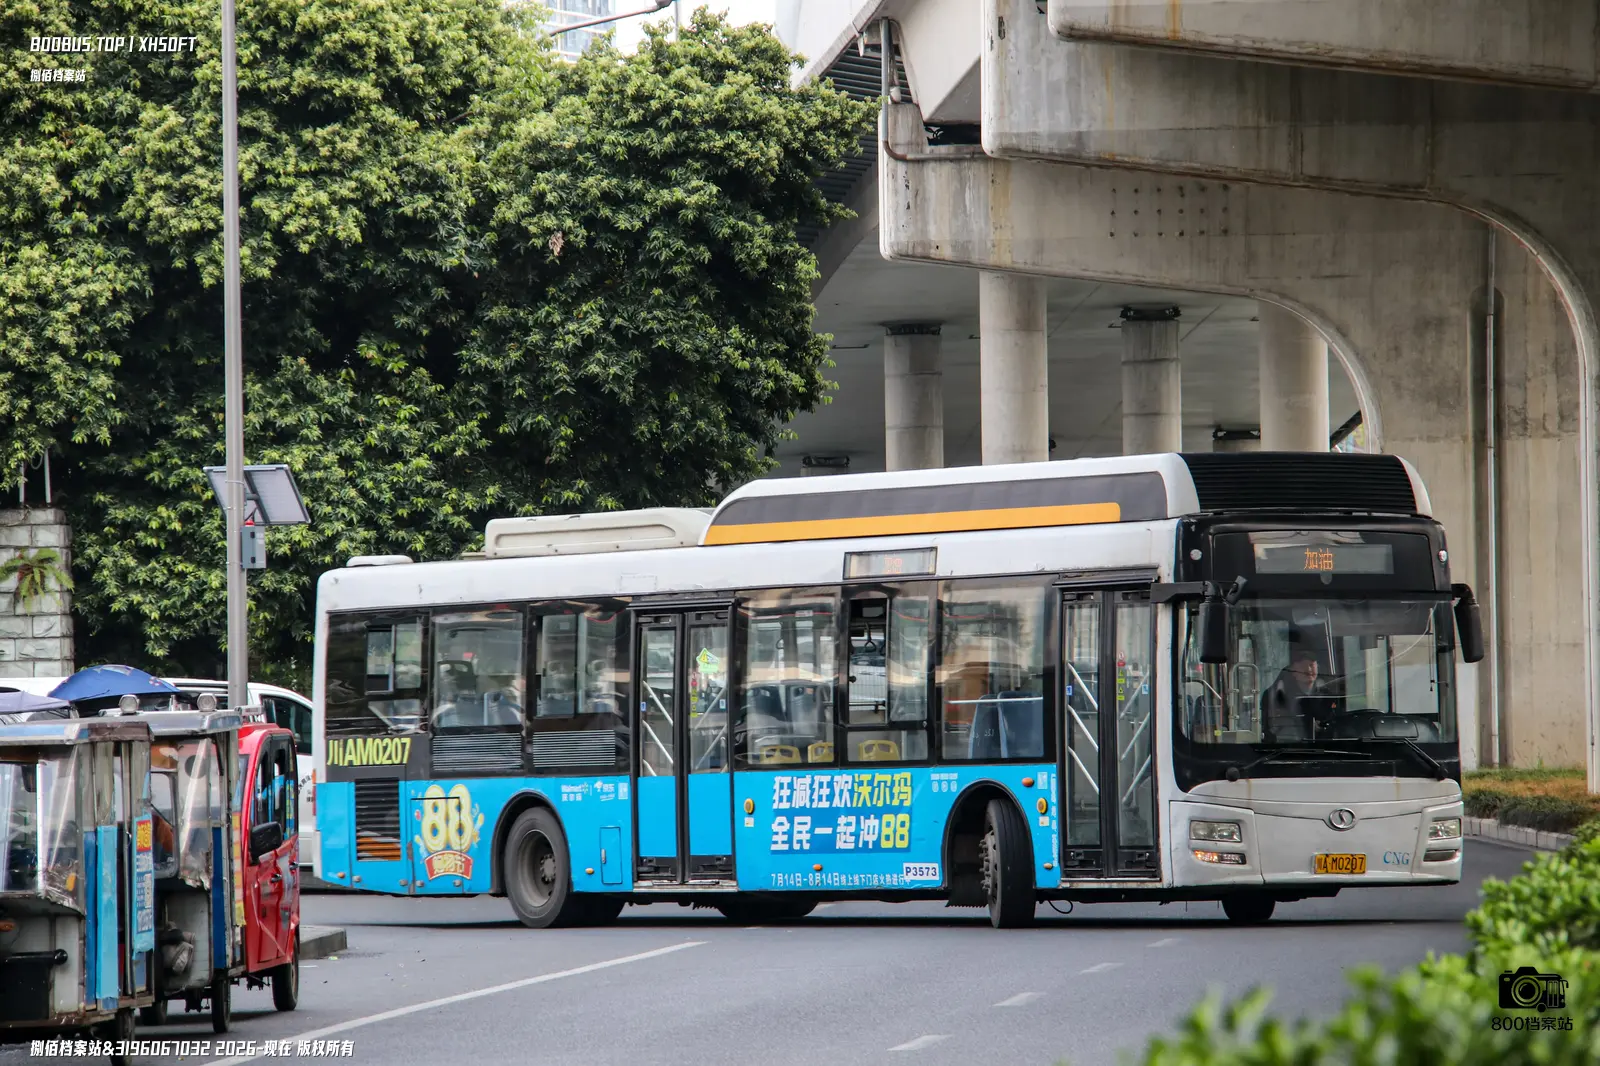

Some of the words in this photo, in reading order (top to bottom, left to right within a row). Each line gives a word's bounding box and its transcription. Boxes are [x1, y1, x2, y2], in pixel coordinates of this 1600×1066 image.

[1304, 548, 1333, 571] 加油
[772, 772, 912, 809] 狂减狂欢沃尔玛
[422, 784, 474, 853] 88
[770, 813, 910, 851] 全民一起冲88
[905, 866, 937, 877] P3573
[1383, 851, 1410, 865] CNG
